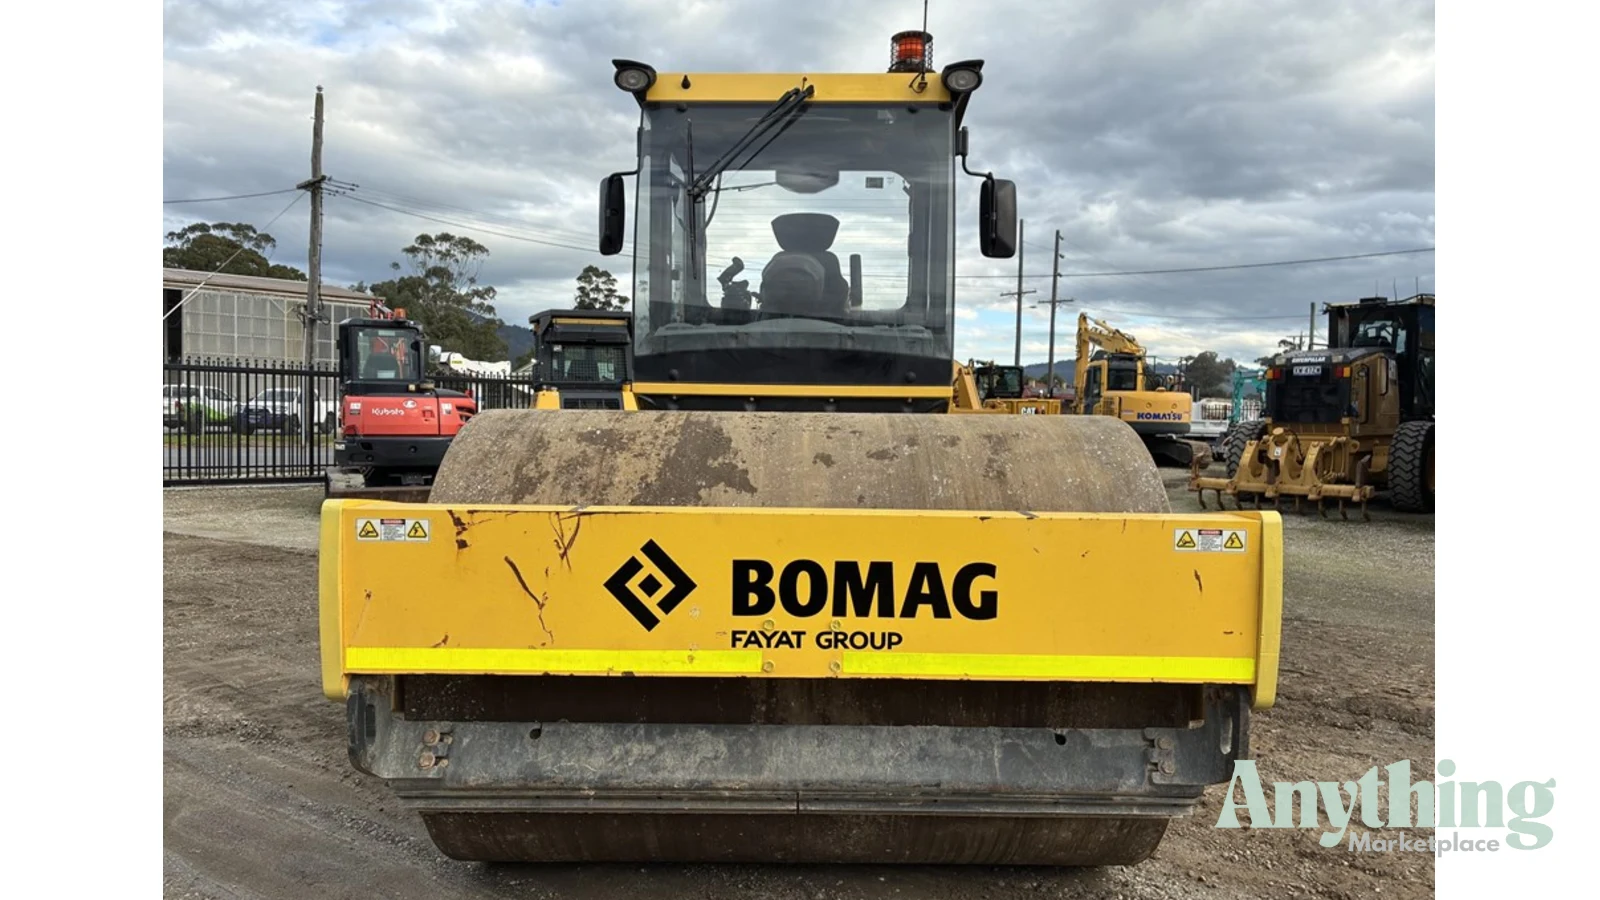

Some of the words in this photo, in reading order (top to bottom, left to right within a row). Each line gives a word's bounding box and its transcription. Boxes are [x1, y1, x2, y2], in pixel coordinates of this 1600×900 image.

[371, 408, 405, 416] Kubota
[1021, 406, 1036, 415] CAT
[1137, 412, 1182, 420] KOMATSU
[731, 558, 999, 621] BOMAG
[731, 630, 807, 649] FAYAT
[815, 631, 903, 650] GROUP
